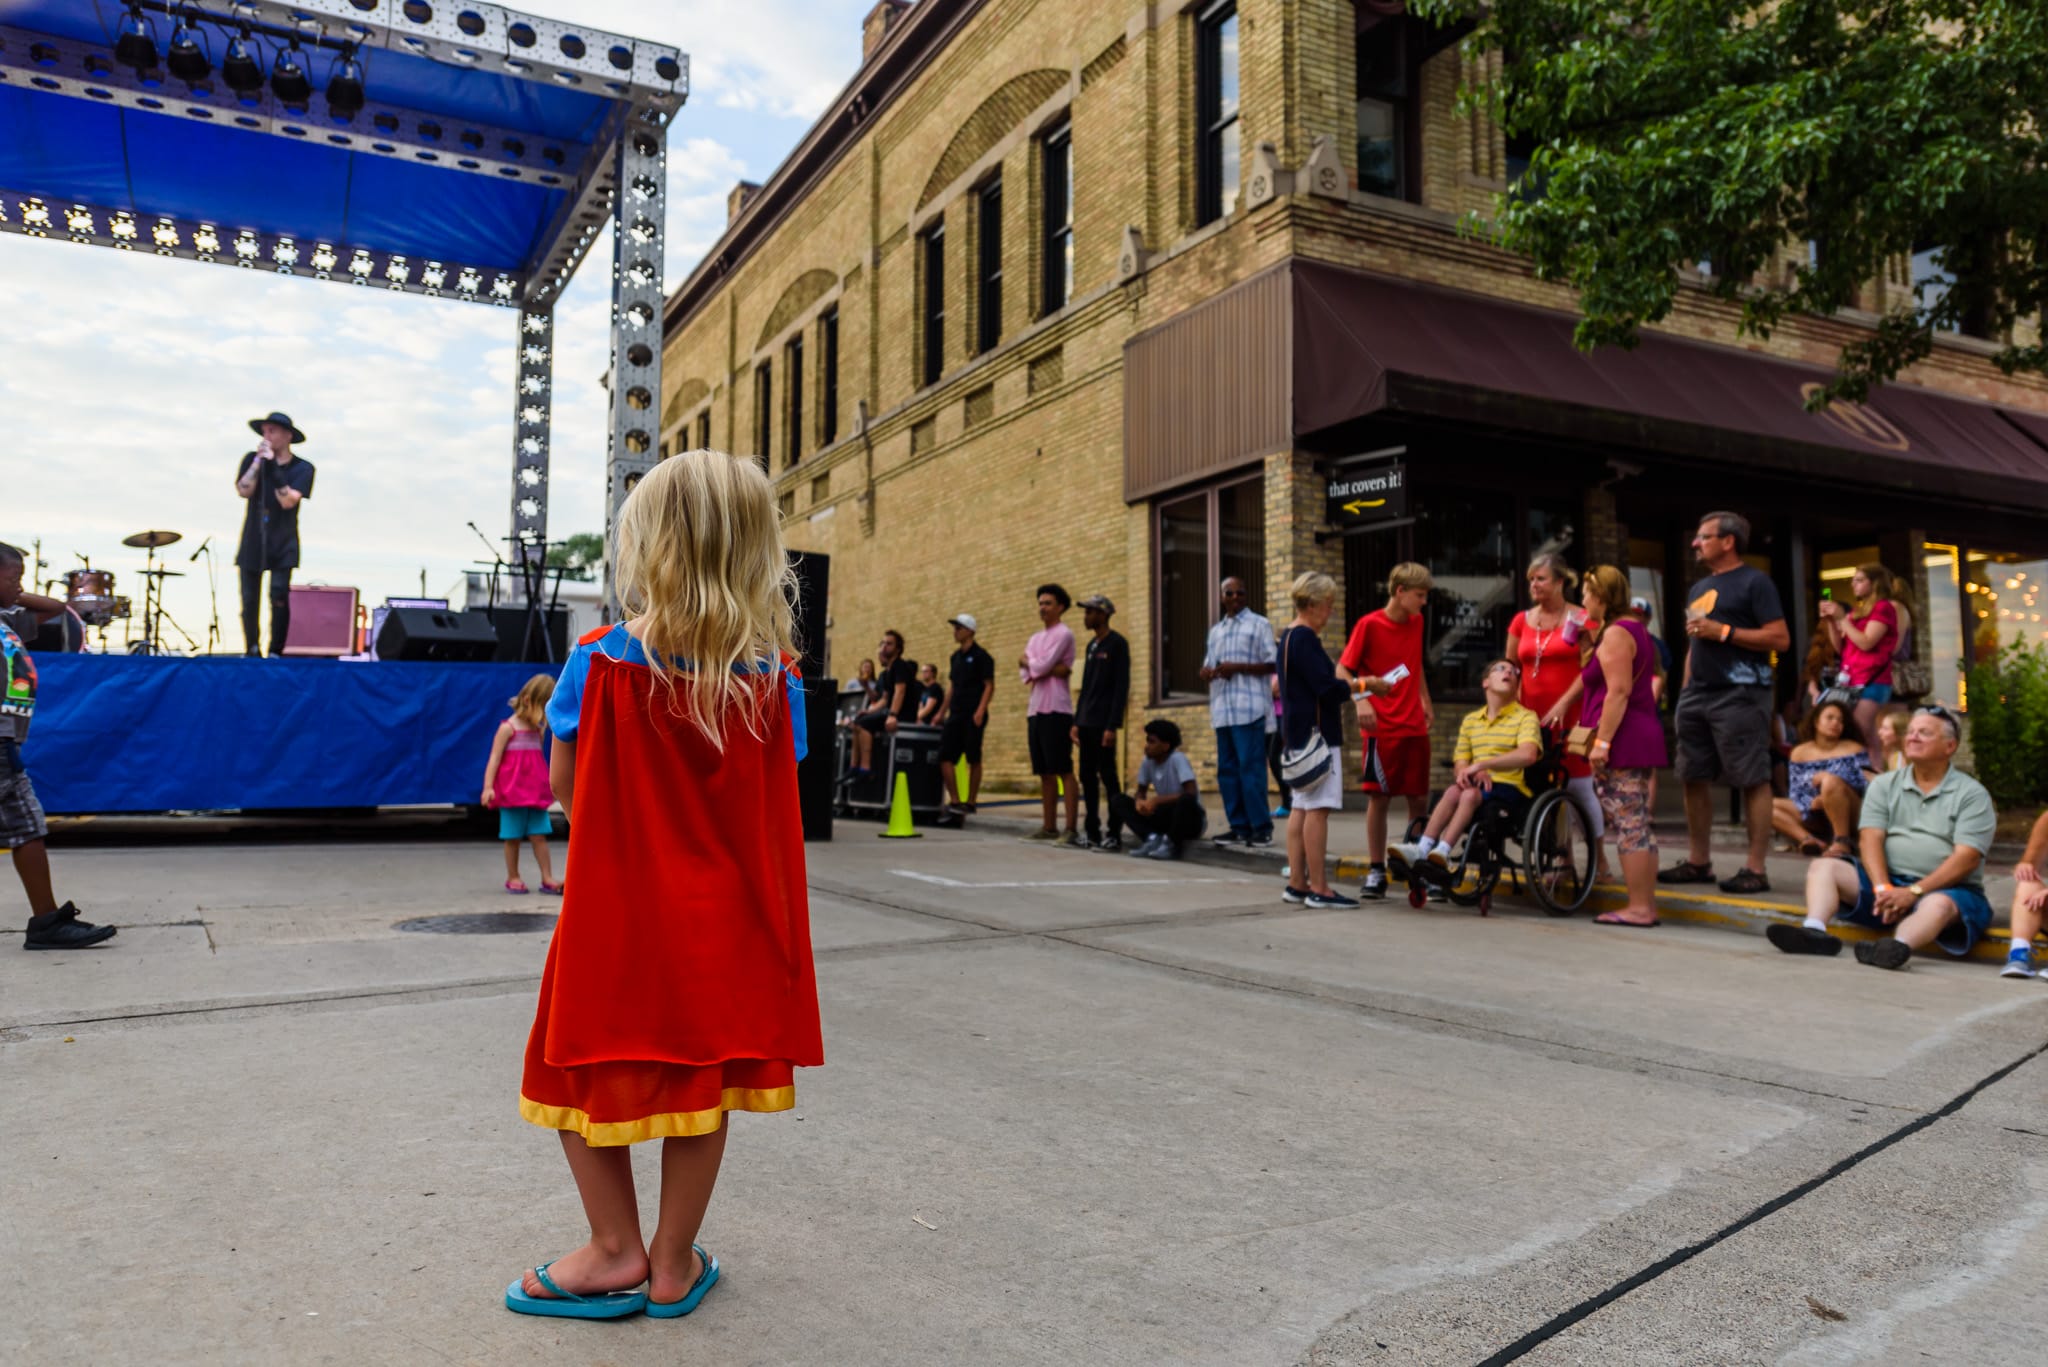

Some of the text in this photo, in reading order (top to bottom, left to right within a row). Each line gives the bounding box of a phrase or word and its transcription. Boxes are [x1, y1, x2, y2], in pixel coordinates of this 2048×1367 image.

[1329, 471, 1402, 497] that covers it!
[1440, 616, 1493, 629] FARMERS
